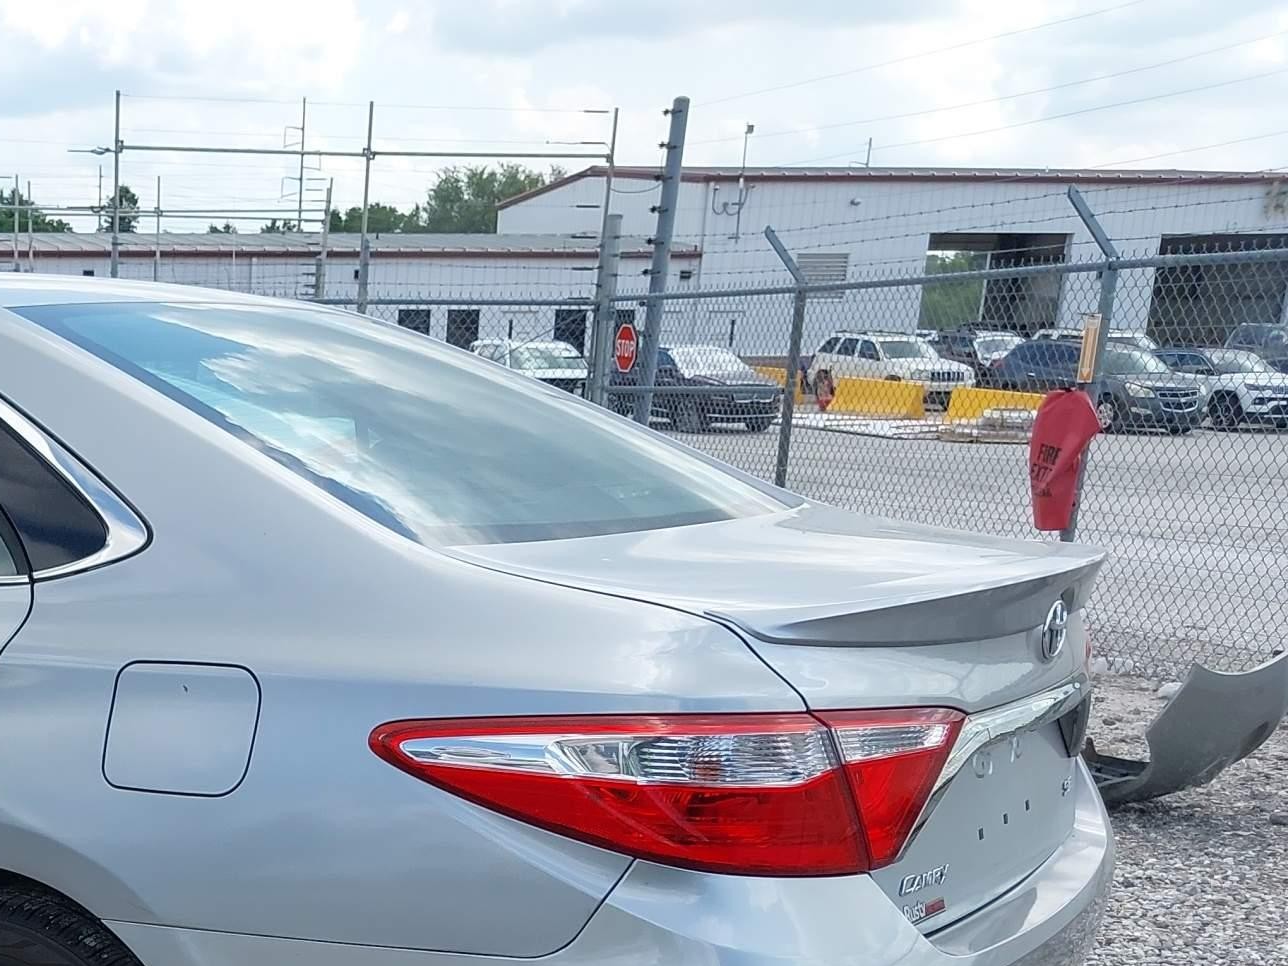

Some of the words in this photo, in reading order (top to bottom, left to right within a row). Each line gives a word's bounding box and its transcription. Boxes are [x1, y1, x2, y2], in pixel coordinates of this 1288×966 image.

[616, 339, 634, 358] STOP
[1036, 443, 1062, 466] FIRE
[900, 863, 949, 896] CAMRY
